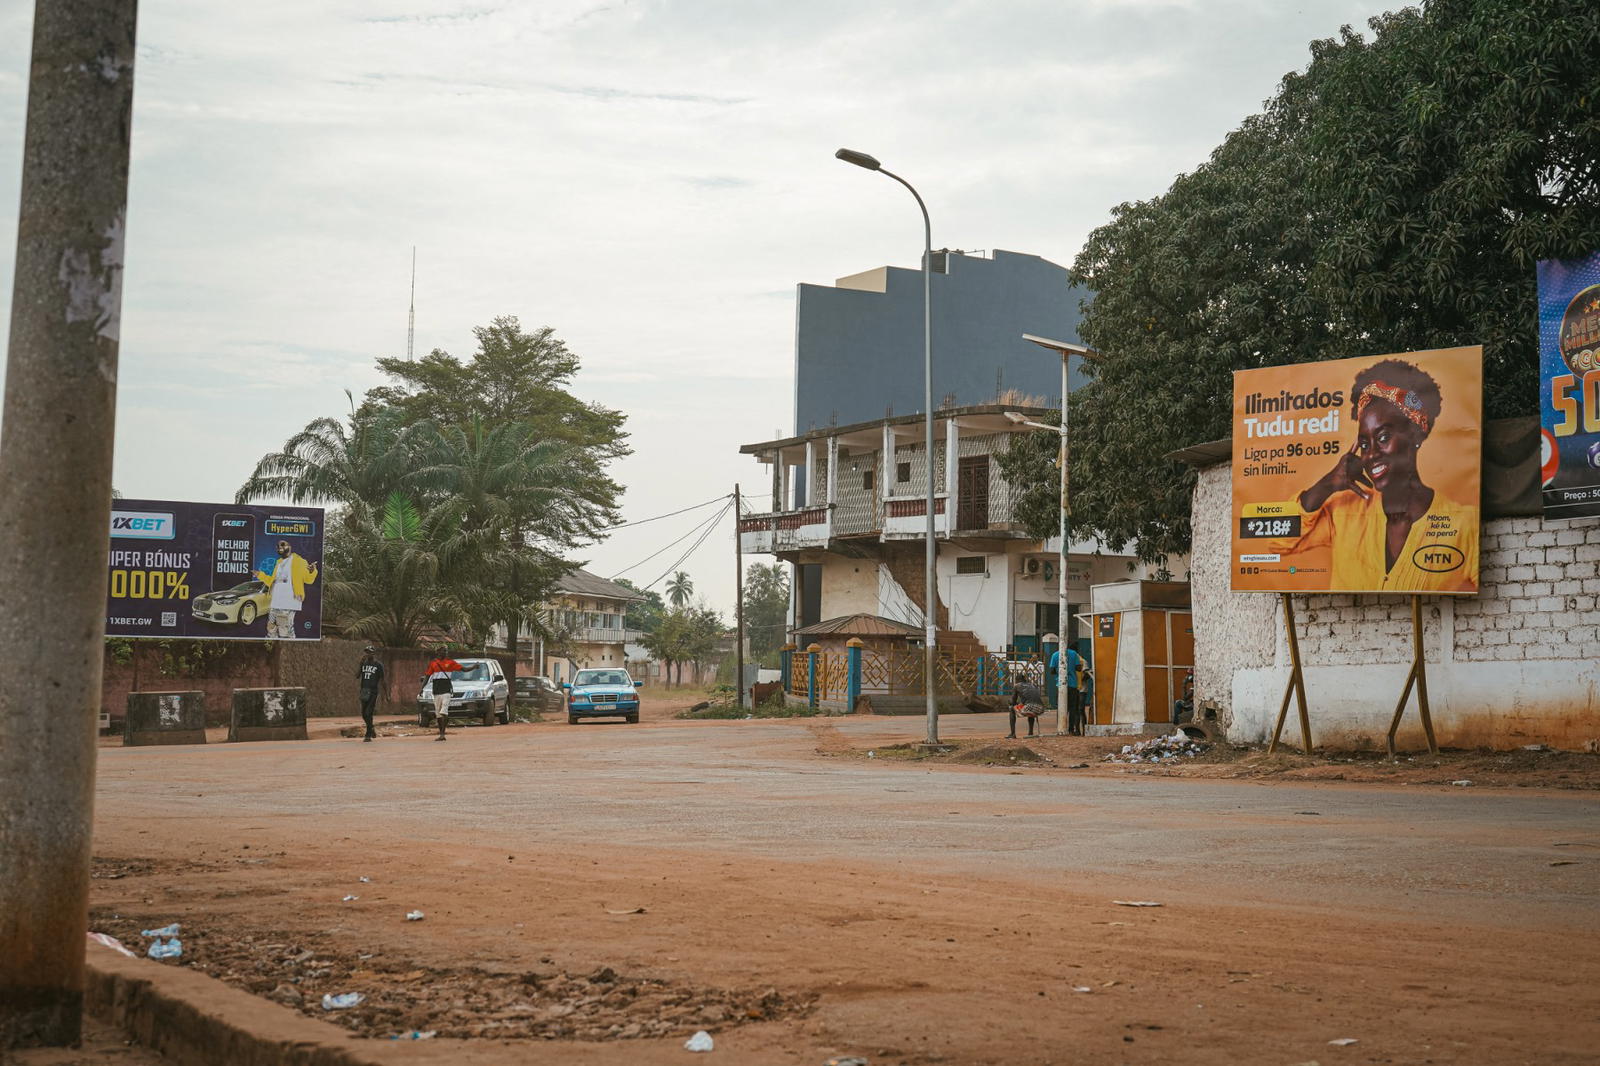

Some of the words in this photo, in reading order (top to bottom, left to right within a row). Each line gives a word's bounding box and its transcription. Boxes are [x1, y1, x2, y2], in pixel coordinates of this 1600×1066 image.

[1571, 314, 1600, 337] ME
[1245, 387, 1344, 415] Ilimitados
[1244, 415, 1294, 438] Tudu
[1298, 409, 1339, 434] redi
[1244, 447, 1268, 462] Liga
[1270, 448, 1284, 461] pa
[1286, 443, 1303, 457] 96
[1305, 446, 1321, 456] ou
[1323, 441, 1340, 455] 95
[1243, 463, 1260, 477] sin
[1563, 491, 1587, 500] Preço
[1256, 506, 1283, 514] Marca:
[217, 540, 249, 549] MELHOR
[107, 550, 141, 567] IPER
[145, 549, 191, 568] BÓNUS
[217, 551, 230, 561] DO
[232, 552, 249, 561] QUE
[1424, 553, 1452, 564] MTN
[216, 561, 249, 573] BÓNUS
[111, 570, 189, 600] 000%
[110, 617, 152, 626] 1XBET.GW
[362, 665, 377, 673] LIKE
